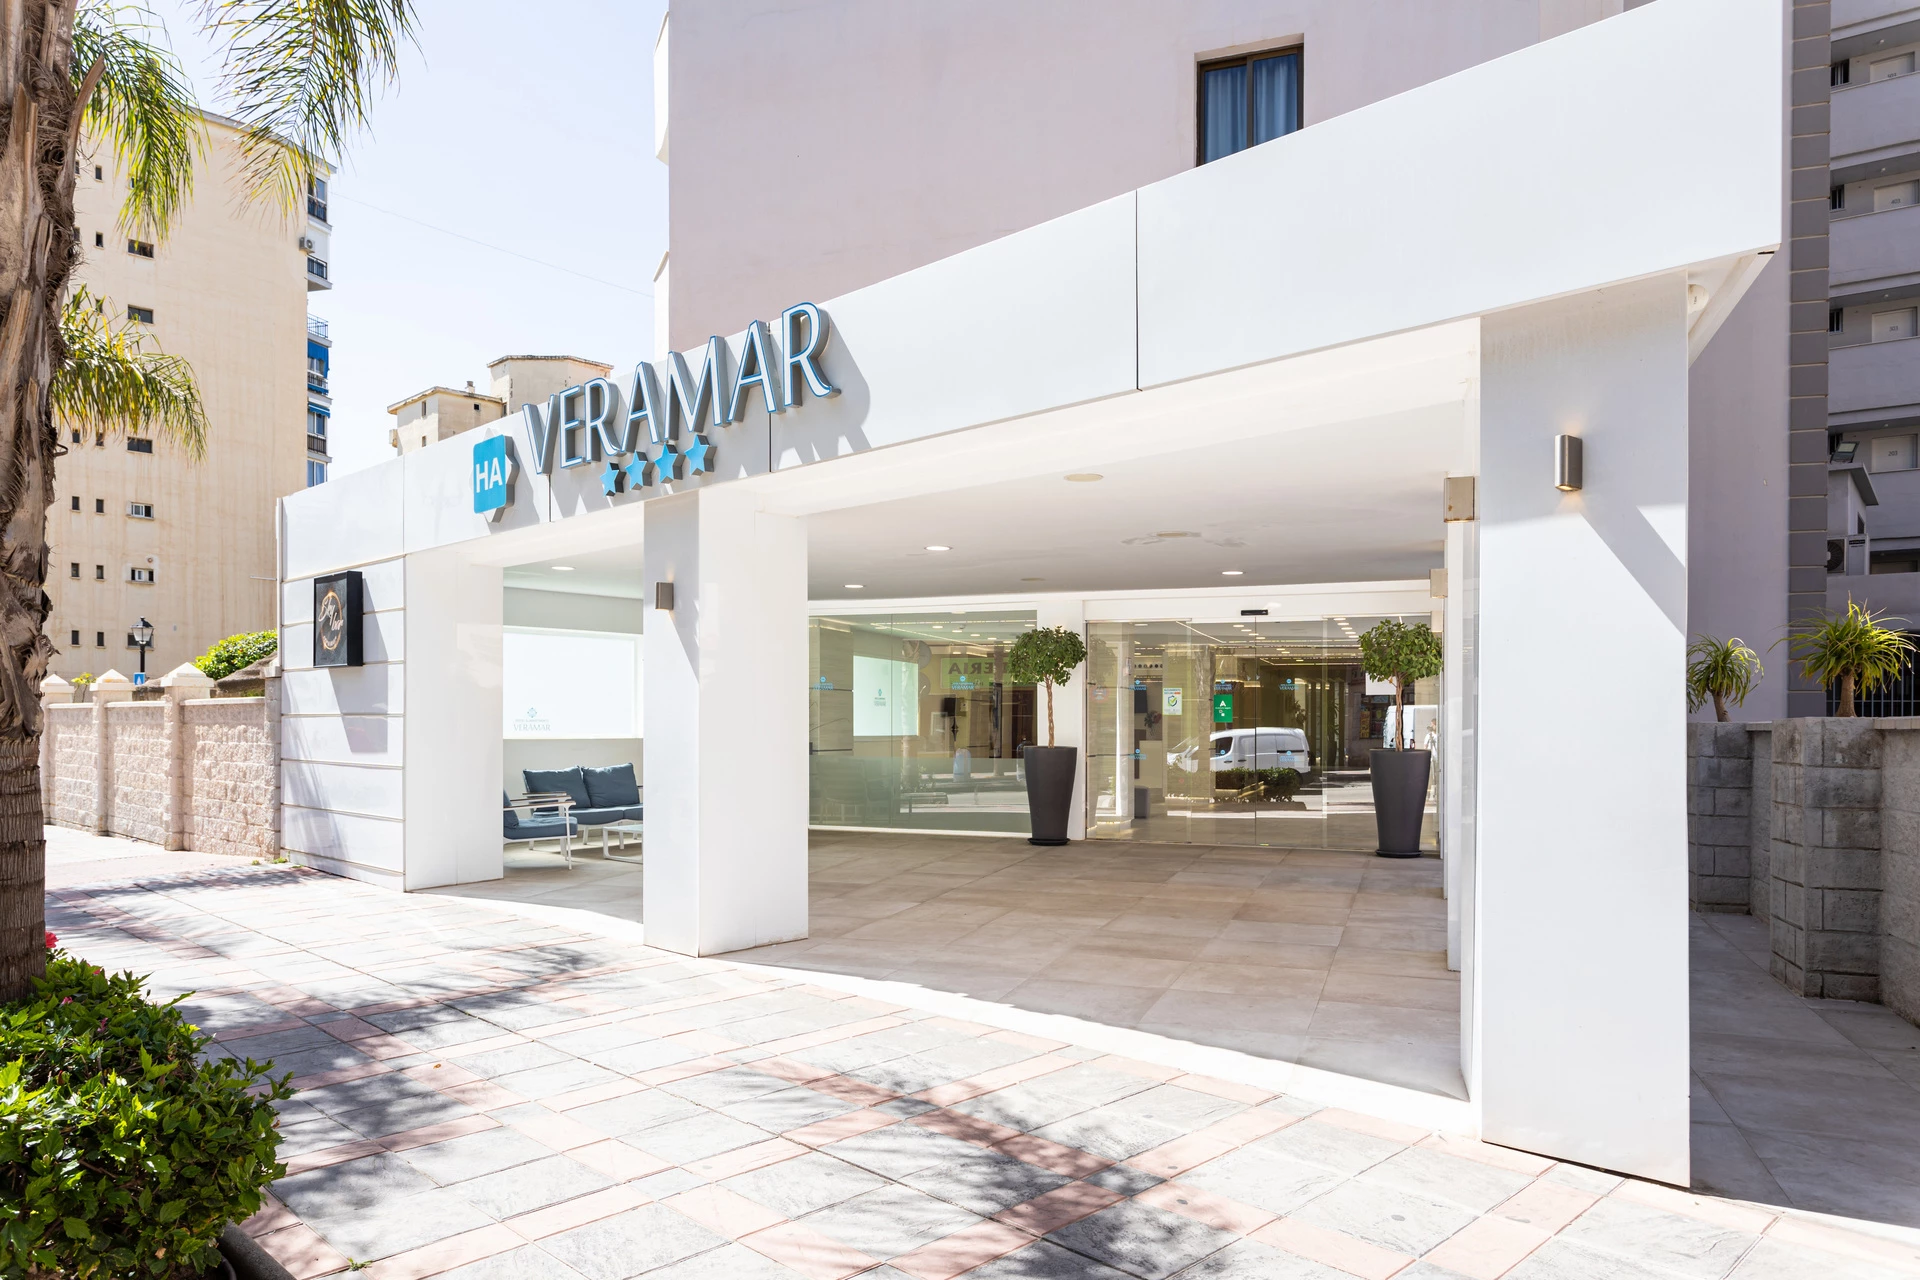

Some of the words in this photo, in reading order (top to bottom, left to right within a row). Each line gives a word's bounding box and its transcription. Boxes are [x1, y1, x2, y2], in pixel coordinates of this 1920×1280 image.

[522, 301, 841, 475] VERAMAR
[473, 456, 503, 493] HA
[513, 723, 551, 731] VERAMAR
